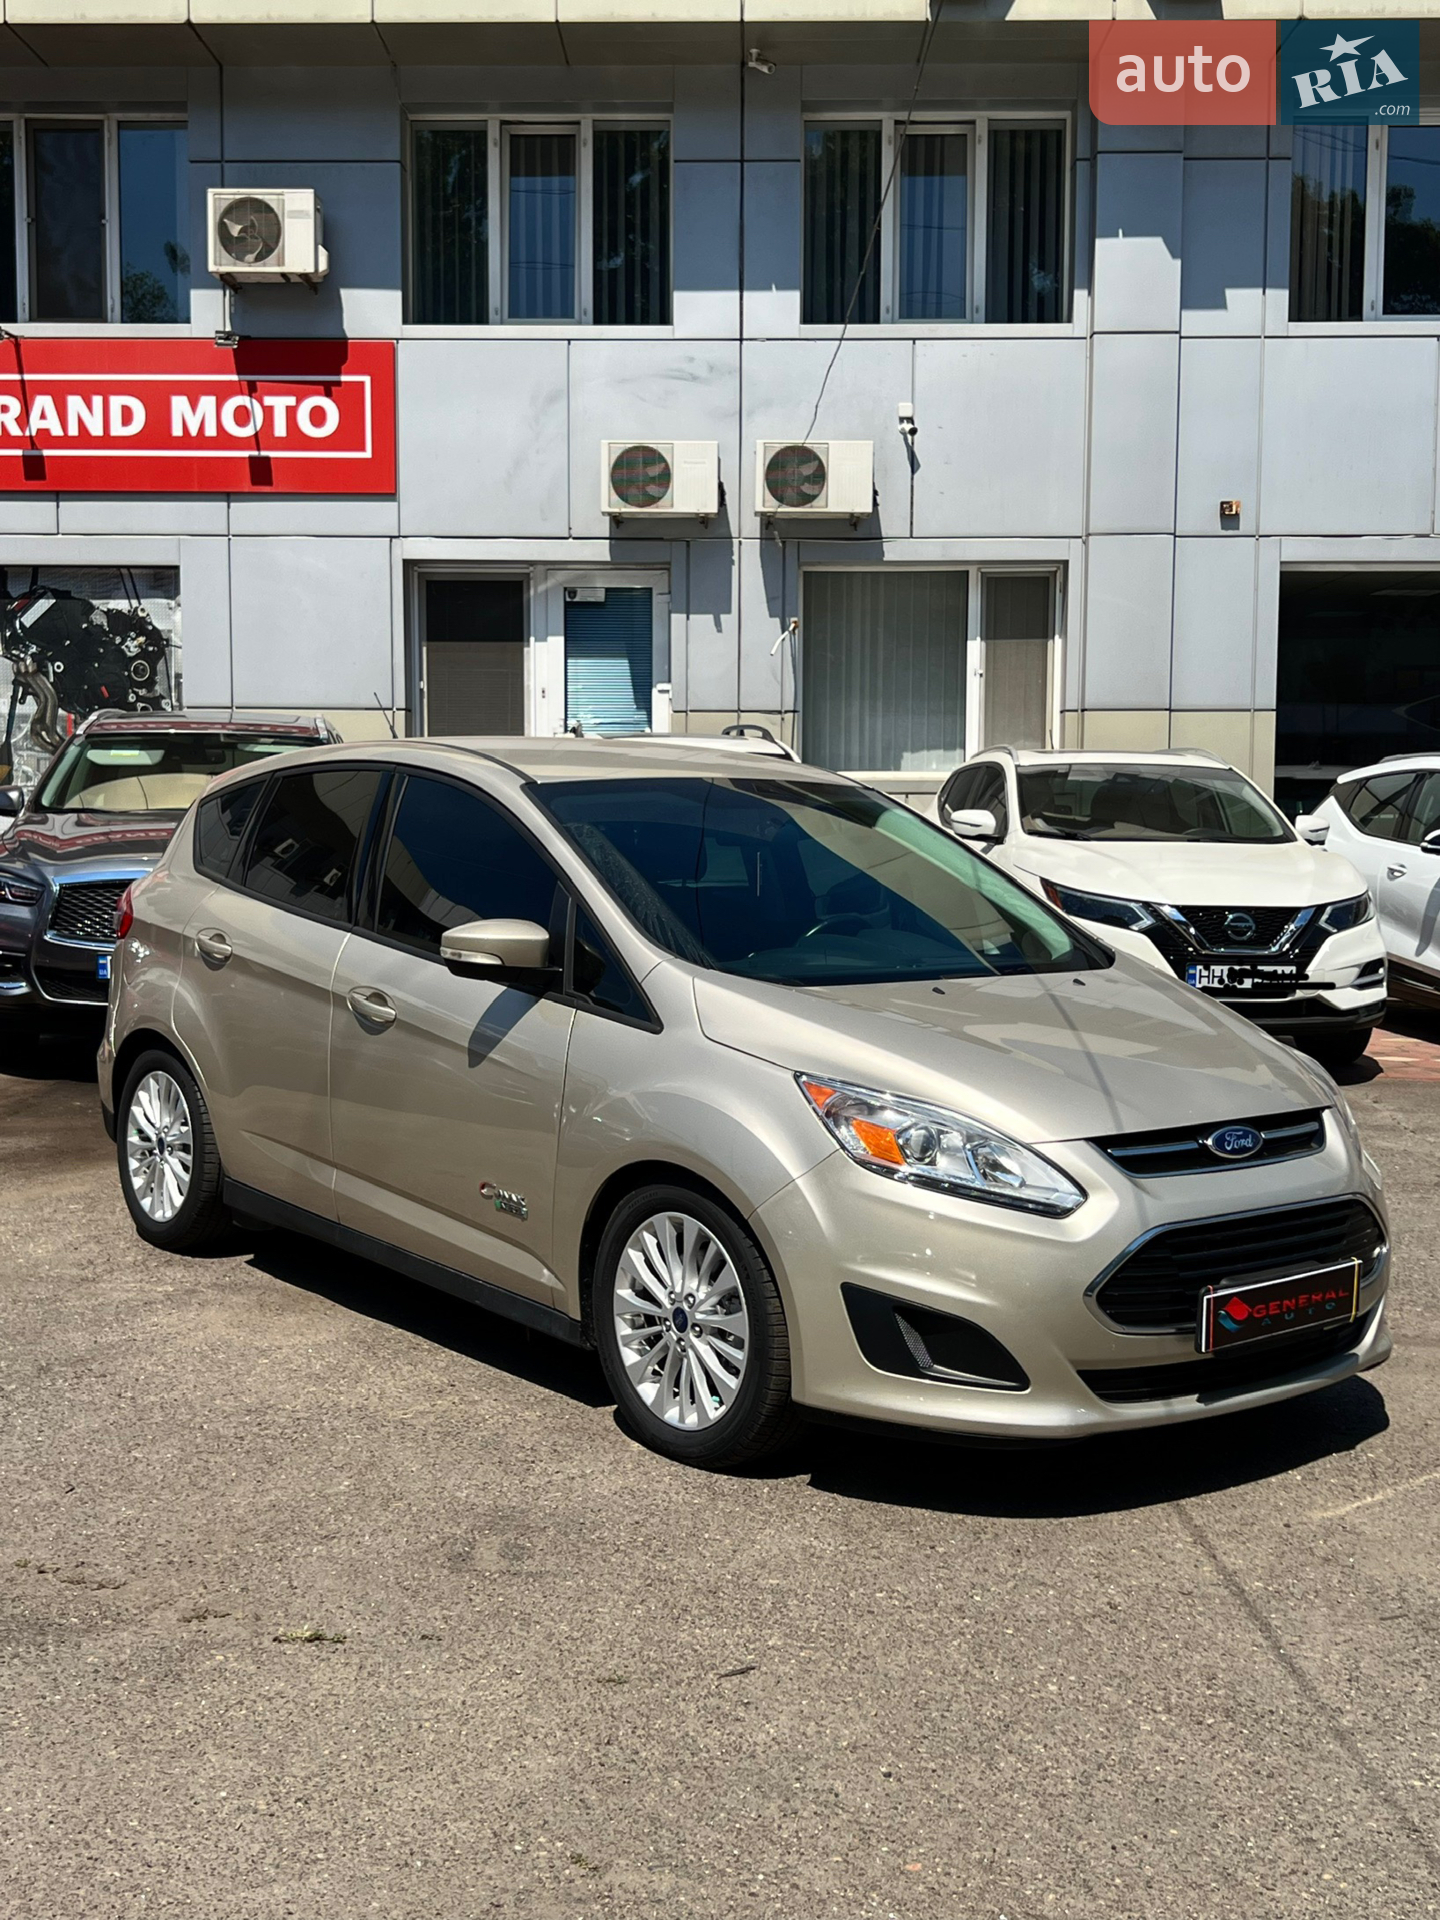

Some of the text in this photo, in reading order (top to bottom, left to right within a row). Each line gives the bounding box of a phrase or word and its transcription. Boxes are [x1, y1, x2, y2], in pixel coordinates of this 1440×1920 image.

[171, 394, 340, 438] MOTO
[1224, 1131, 1253, 1151] Ford
[1252, 1288, 1349, 1318] GENERAL
[1261, 1302, 1336, 1326] AUTO
